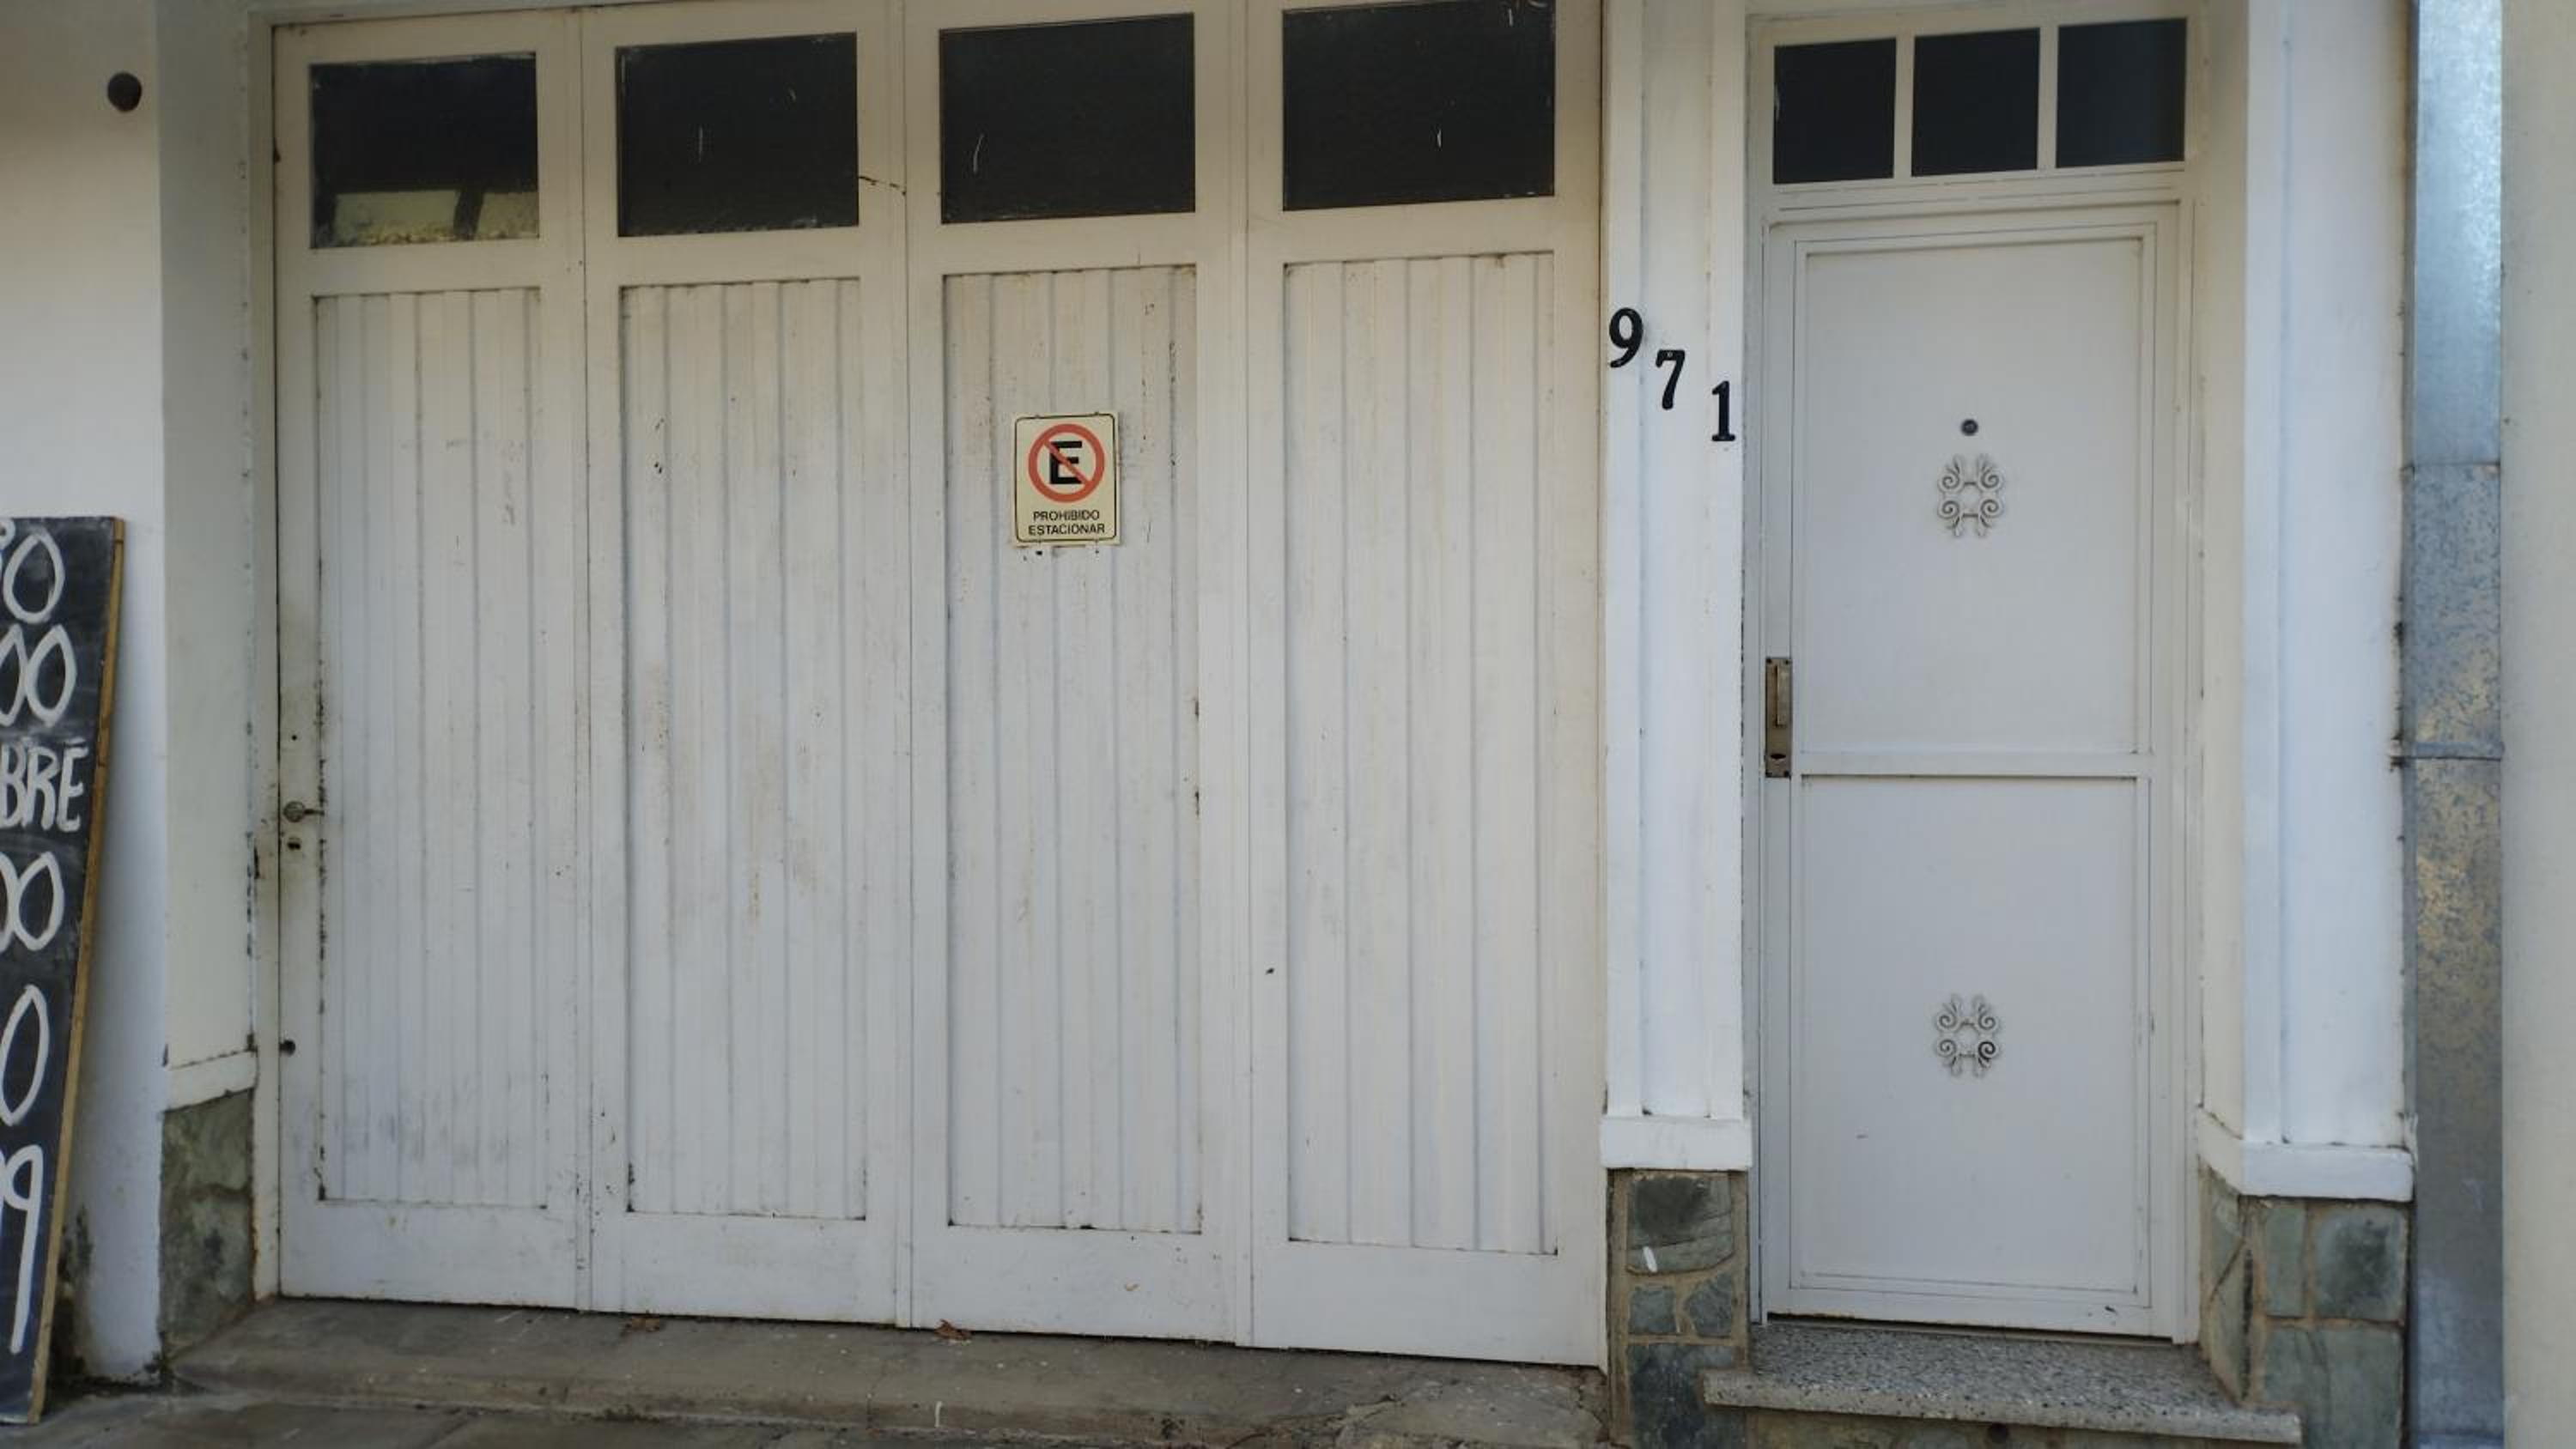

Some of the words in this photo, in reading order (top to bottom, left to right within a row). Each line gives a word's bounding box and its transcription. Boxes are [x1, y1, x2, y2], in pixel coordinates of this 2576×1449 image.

[1608, 307, 1736, 441] 971
[1049, 440, 1084, 484] E
[1028, 523, 1105, 536] ESTACIONAR
[1033, 509, 1100, 522] PROHIBIDO
[0, 518, 65, 624] 0
[0, 1144, 44, 1354] 9
